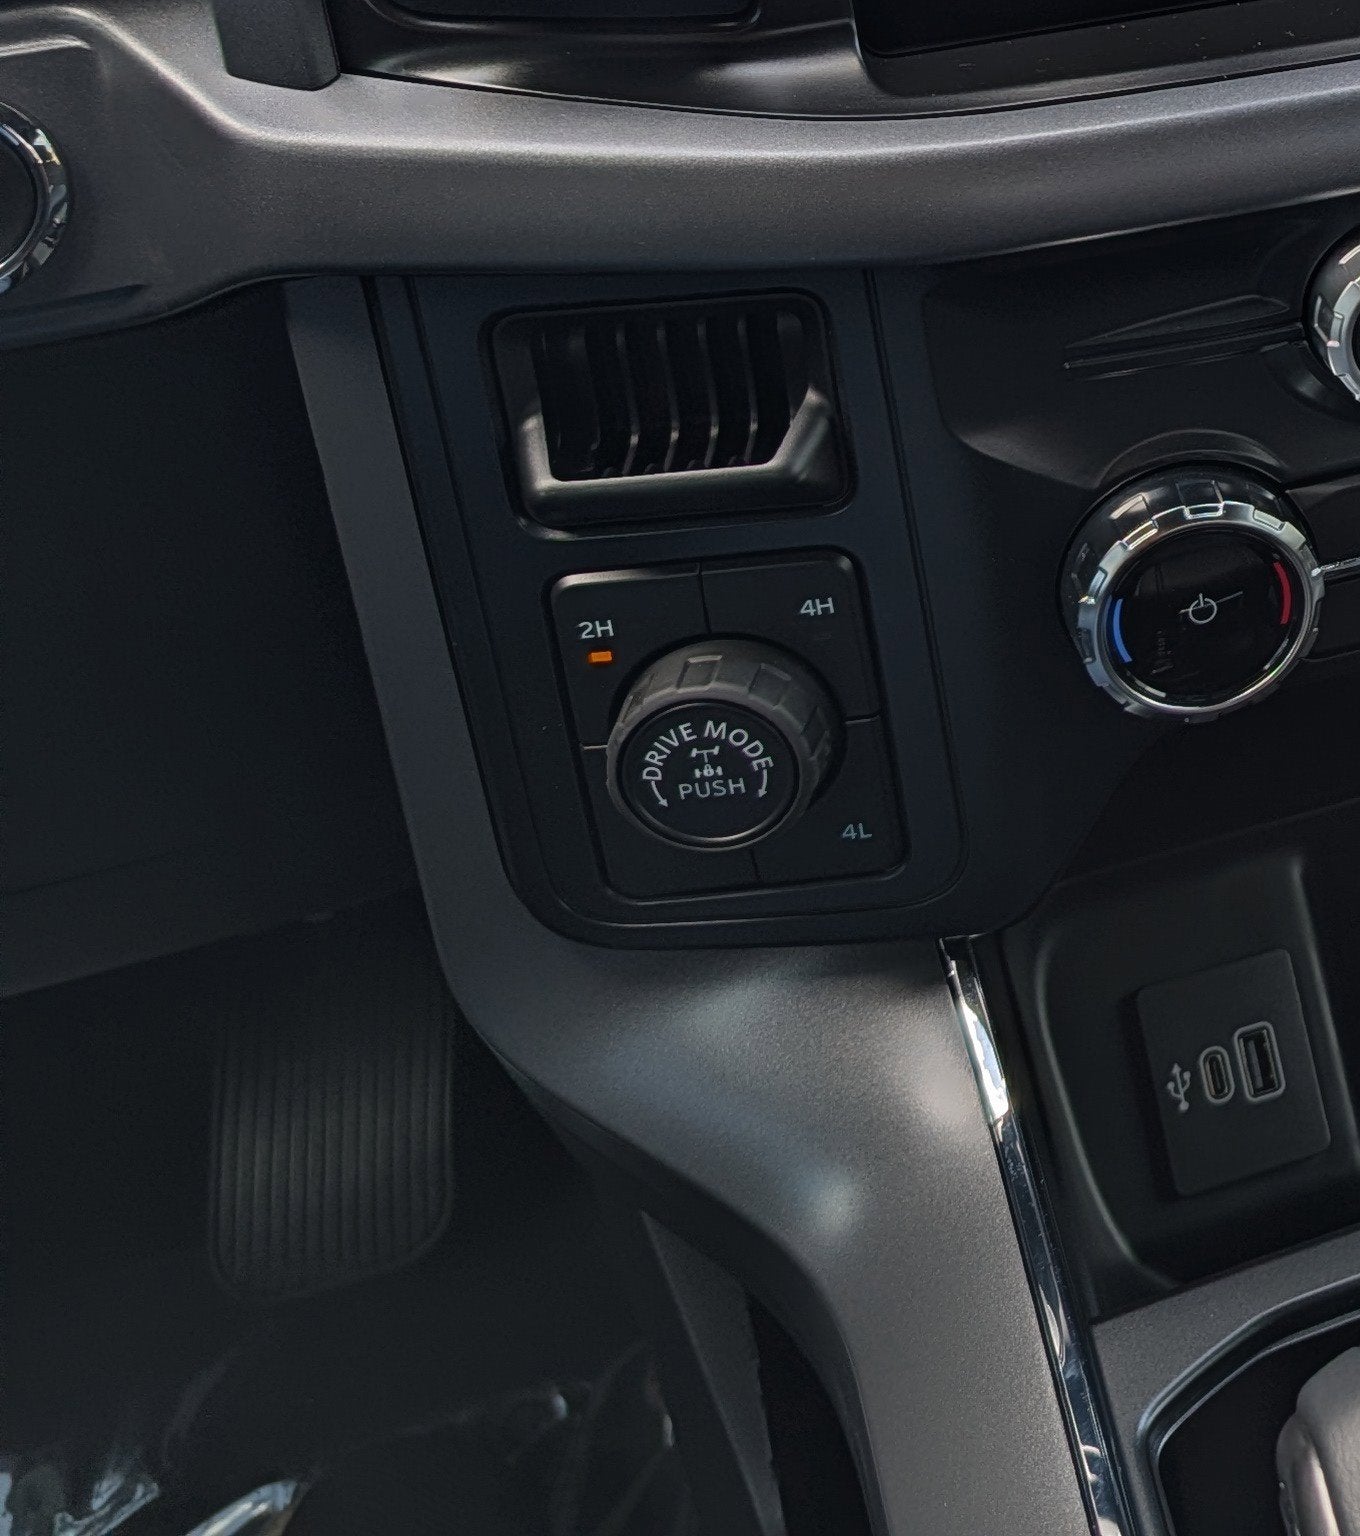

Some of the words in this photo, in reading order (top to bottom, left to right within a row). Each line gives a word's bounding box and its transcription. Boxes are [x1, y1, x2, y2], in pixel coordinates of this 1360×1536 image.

[800, 597, 835, 617] 4H
[578, 619, 615, 639] 2H
[642, 722, 698, 783] DRIVE
[703, 720, 774, 770] MODE
[679, 778, 747, 800] PUSH
[840, 823, 872, 840] 4L
